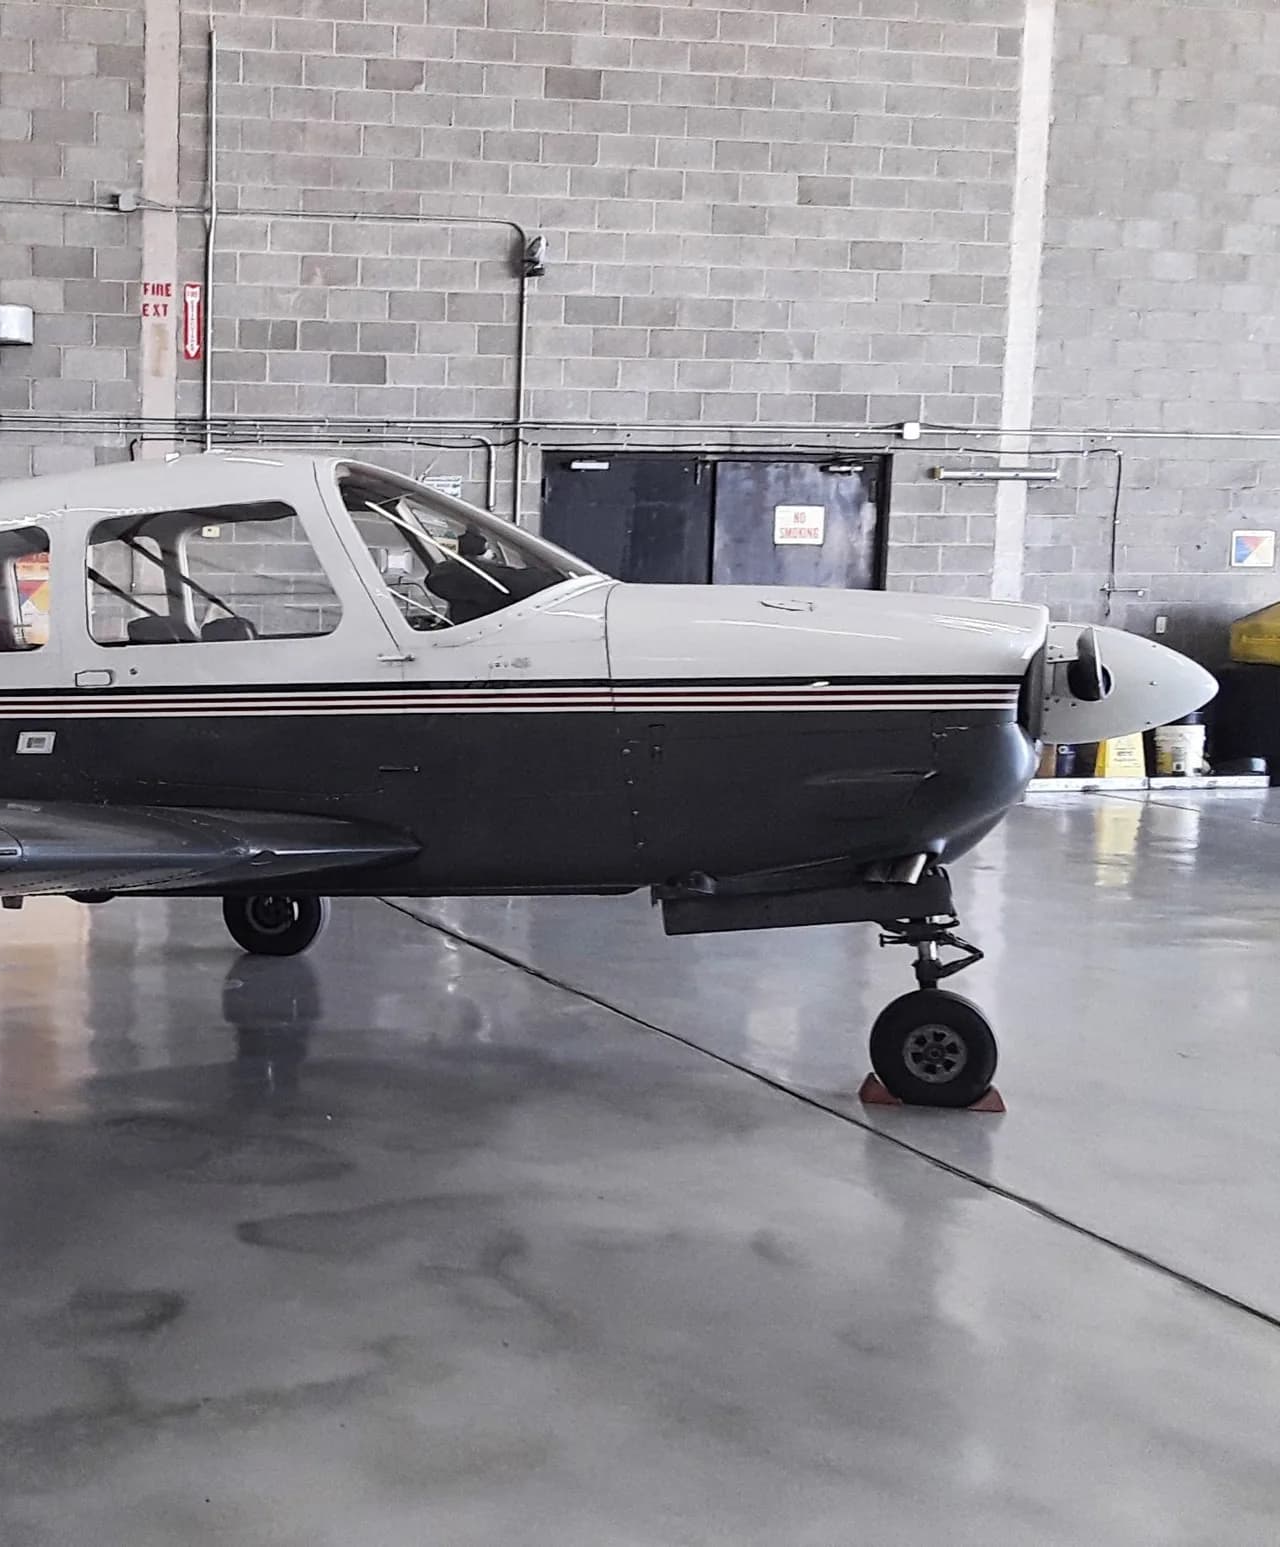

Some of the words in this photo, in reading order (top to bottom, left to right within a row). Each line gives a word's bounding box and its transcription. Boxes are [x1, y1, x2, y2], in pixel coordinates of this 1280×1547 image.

[144, 283, 172, 297] FIRE
[142, 303, 168, 317] EXT
[793, 511, 807, 524] NO
[779, 527, 819, 539] SMOKING
